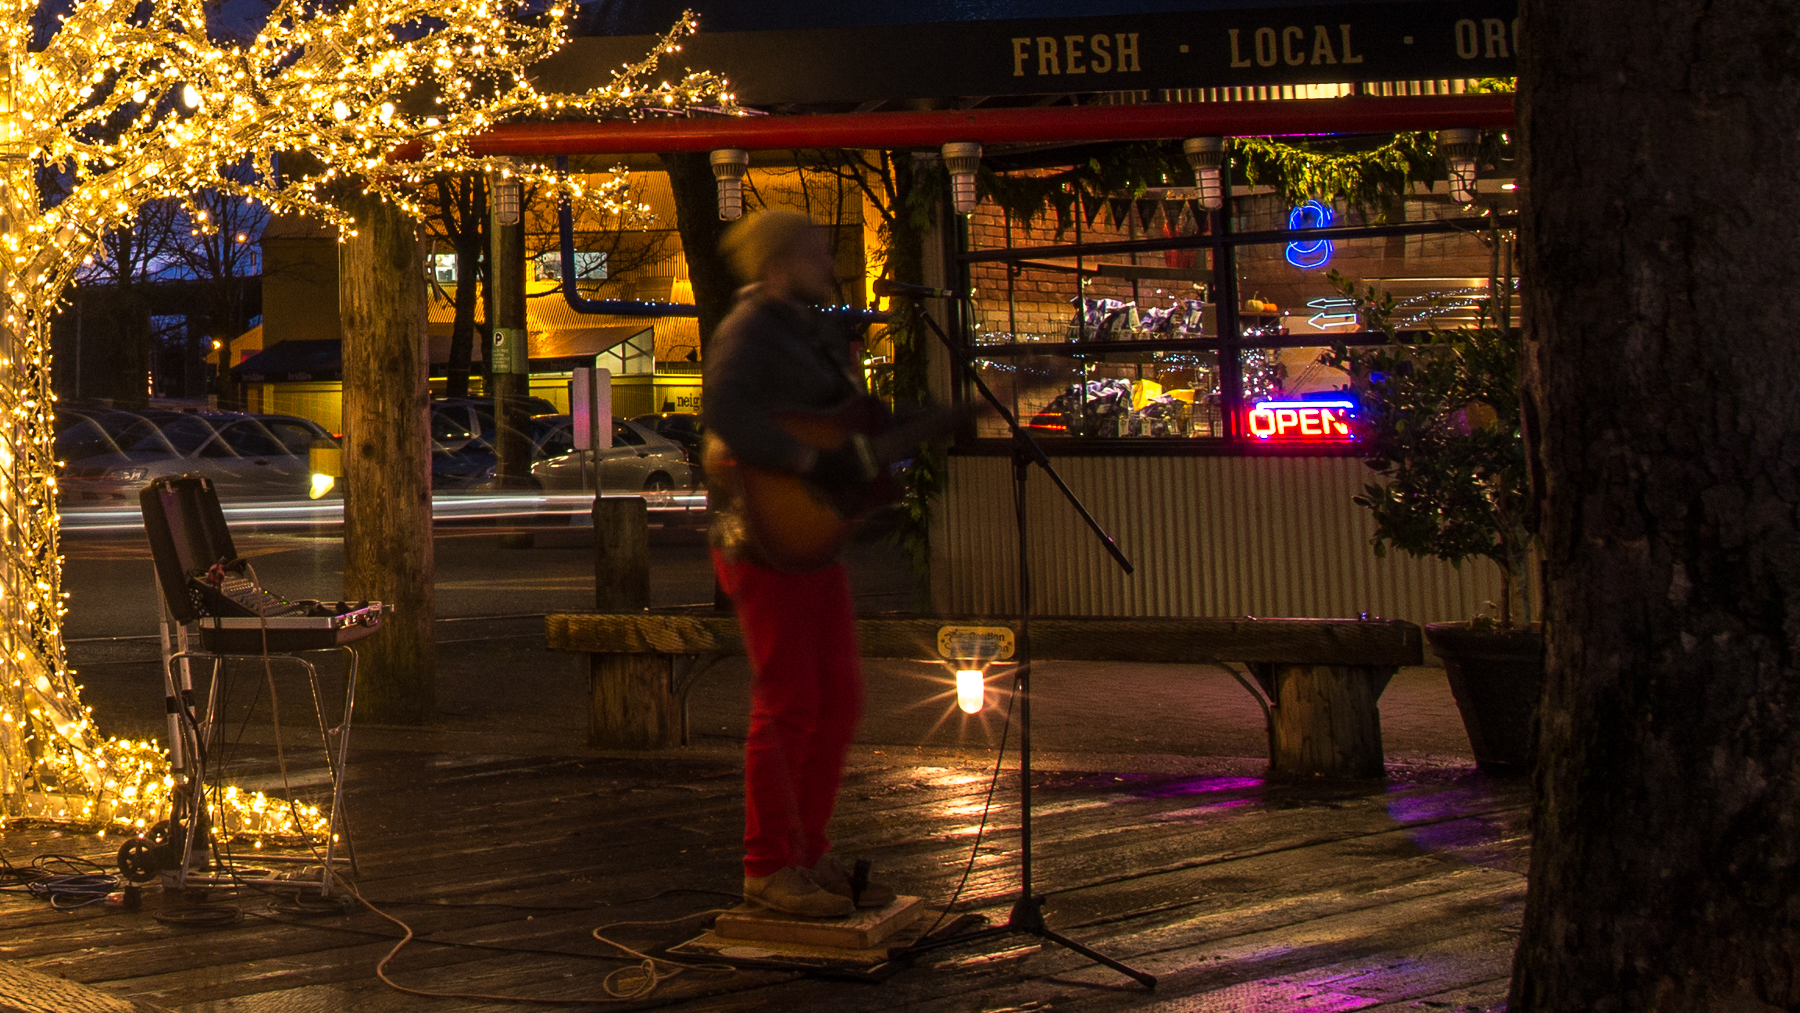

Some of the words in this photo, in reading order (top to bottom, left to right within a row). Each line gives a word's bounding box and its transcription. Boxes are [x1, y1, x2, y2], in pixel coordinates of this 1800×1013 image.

[1011, 33, 1141, 77] FRESH
[1228, 23, 1363, 68] LOCAL
[677, 393, 702, 412] neig
[1248, 409, 1349, 435] OPEN
